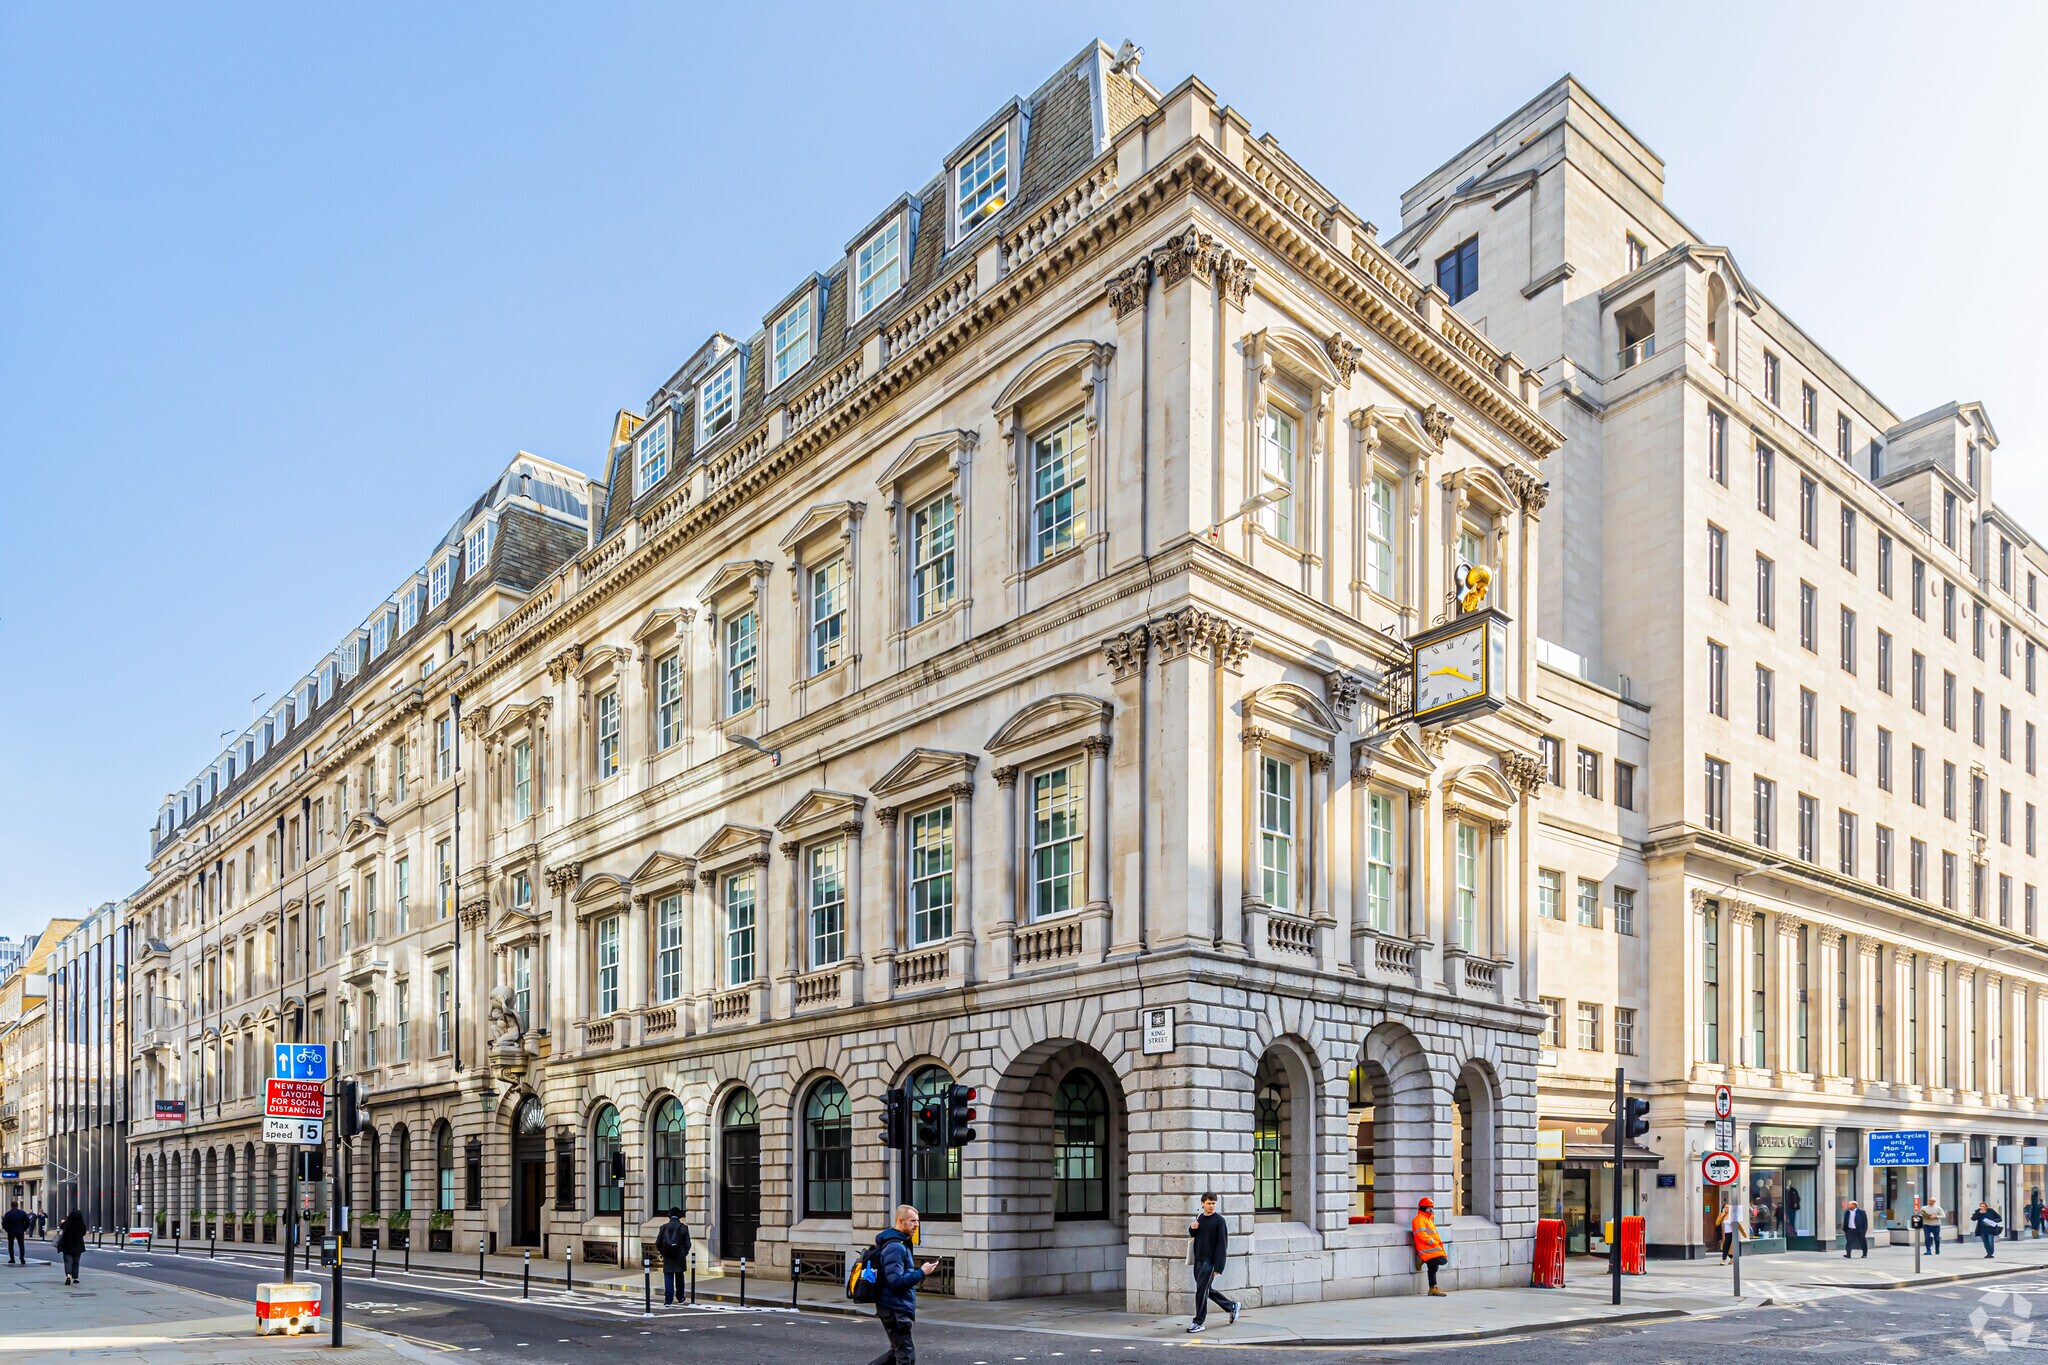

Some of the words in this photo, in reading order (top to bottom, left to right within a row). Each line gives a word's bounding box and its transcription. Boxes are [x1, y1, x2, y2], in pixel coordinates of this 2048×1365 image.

[296, 1084, 319, 1092] ROAD
[281, 1091, 312, 1099] LAYOUT
[291, 1099, 320, 1108] SOCIAL
[270, 1106, 322, 1115] DISTANCING
[298, 1125, 318, 1140] 15
